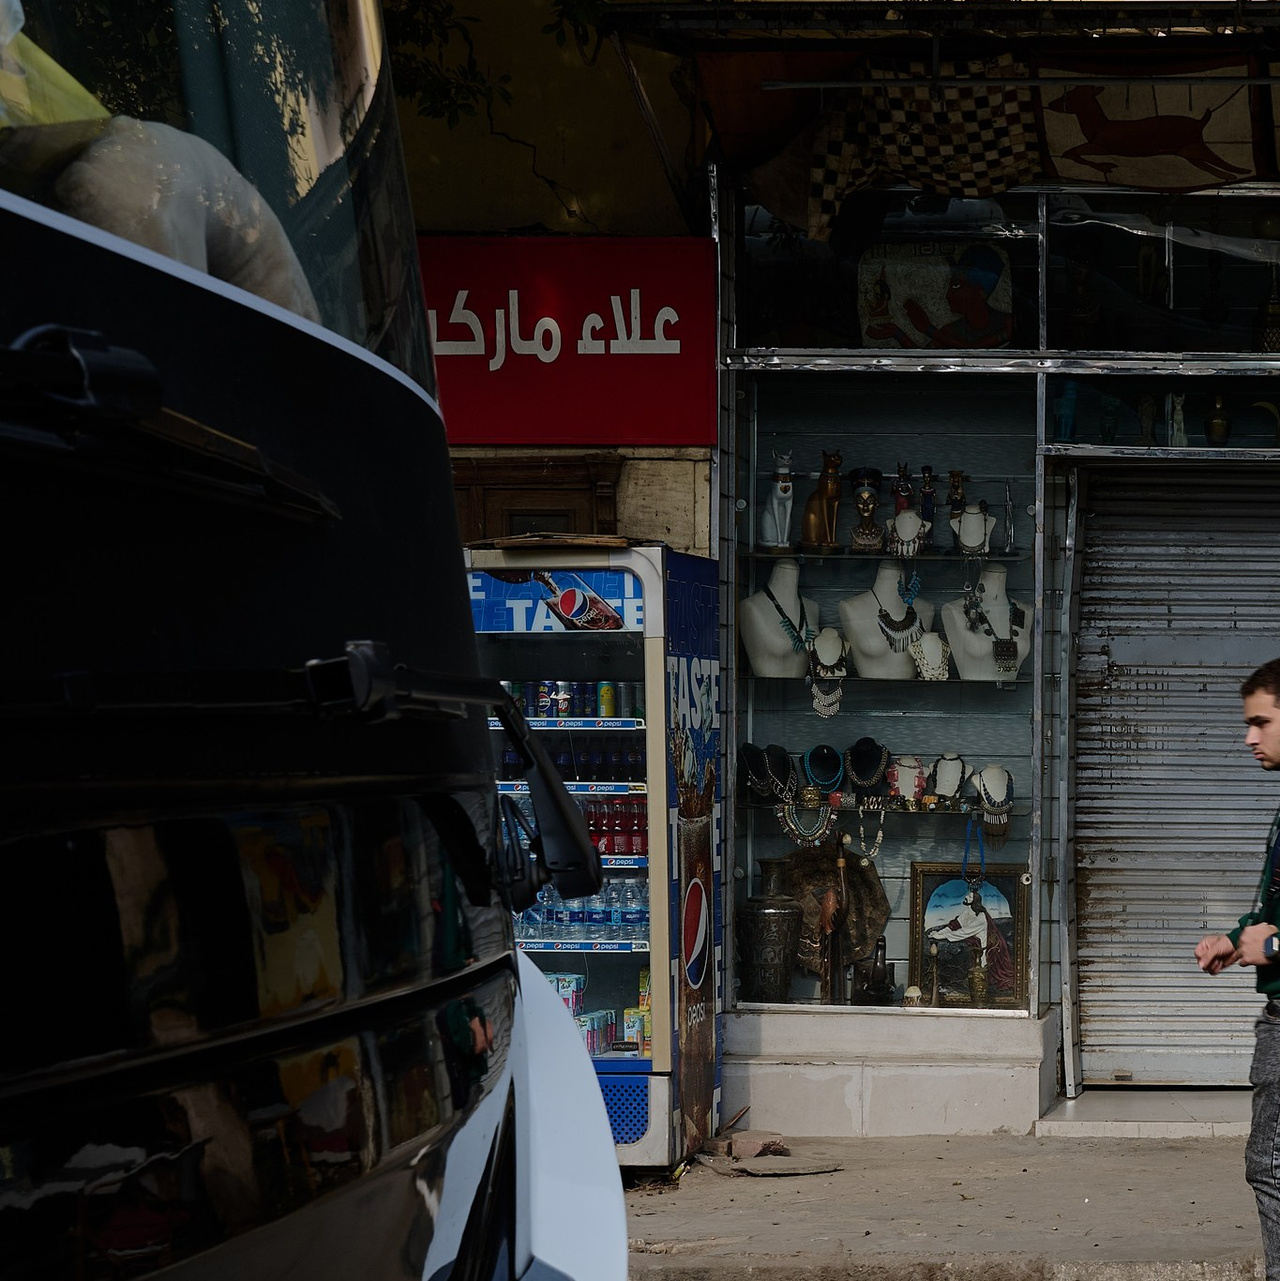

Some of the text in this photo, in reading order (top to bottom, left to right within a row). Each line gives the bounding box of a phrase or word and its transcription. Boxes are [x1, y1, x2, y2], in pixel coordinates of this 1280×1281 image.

[577, 288, 681, 355] علاء
[667, 656, 720, 730] TASTE
[565, 720, 583, 728] pepsi
[603, 720, 622, 728] pepsi
[597, 785, 615, 793] pepsi
[616, 858, 634, 866] pepsi
[687, 999, 706, 1027] pepsi
